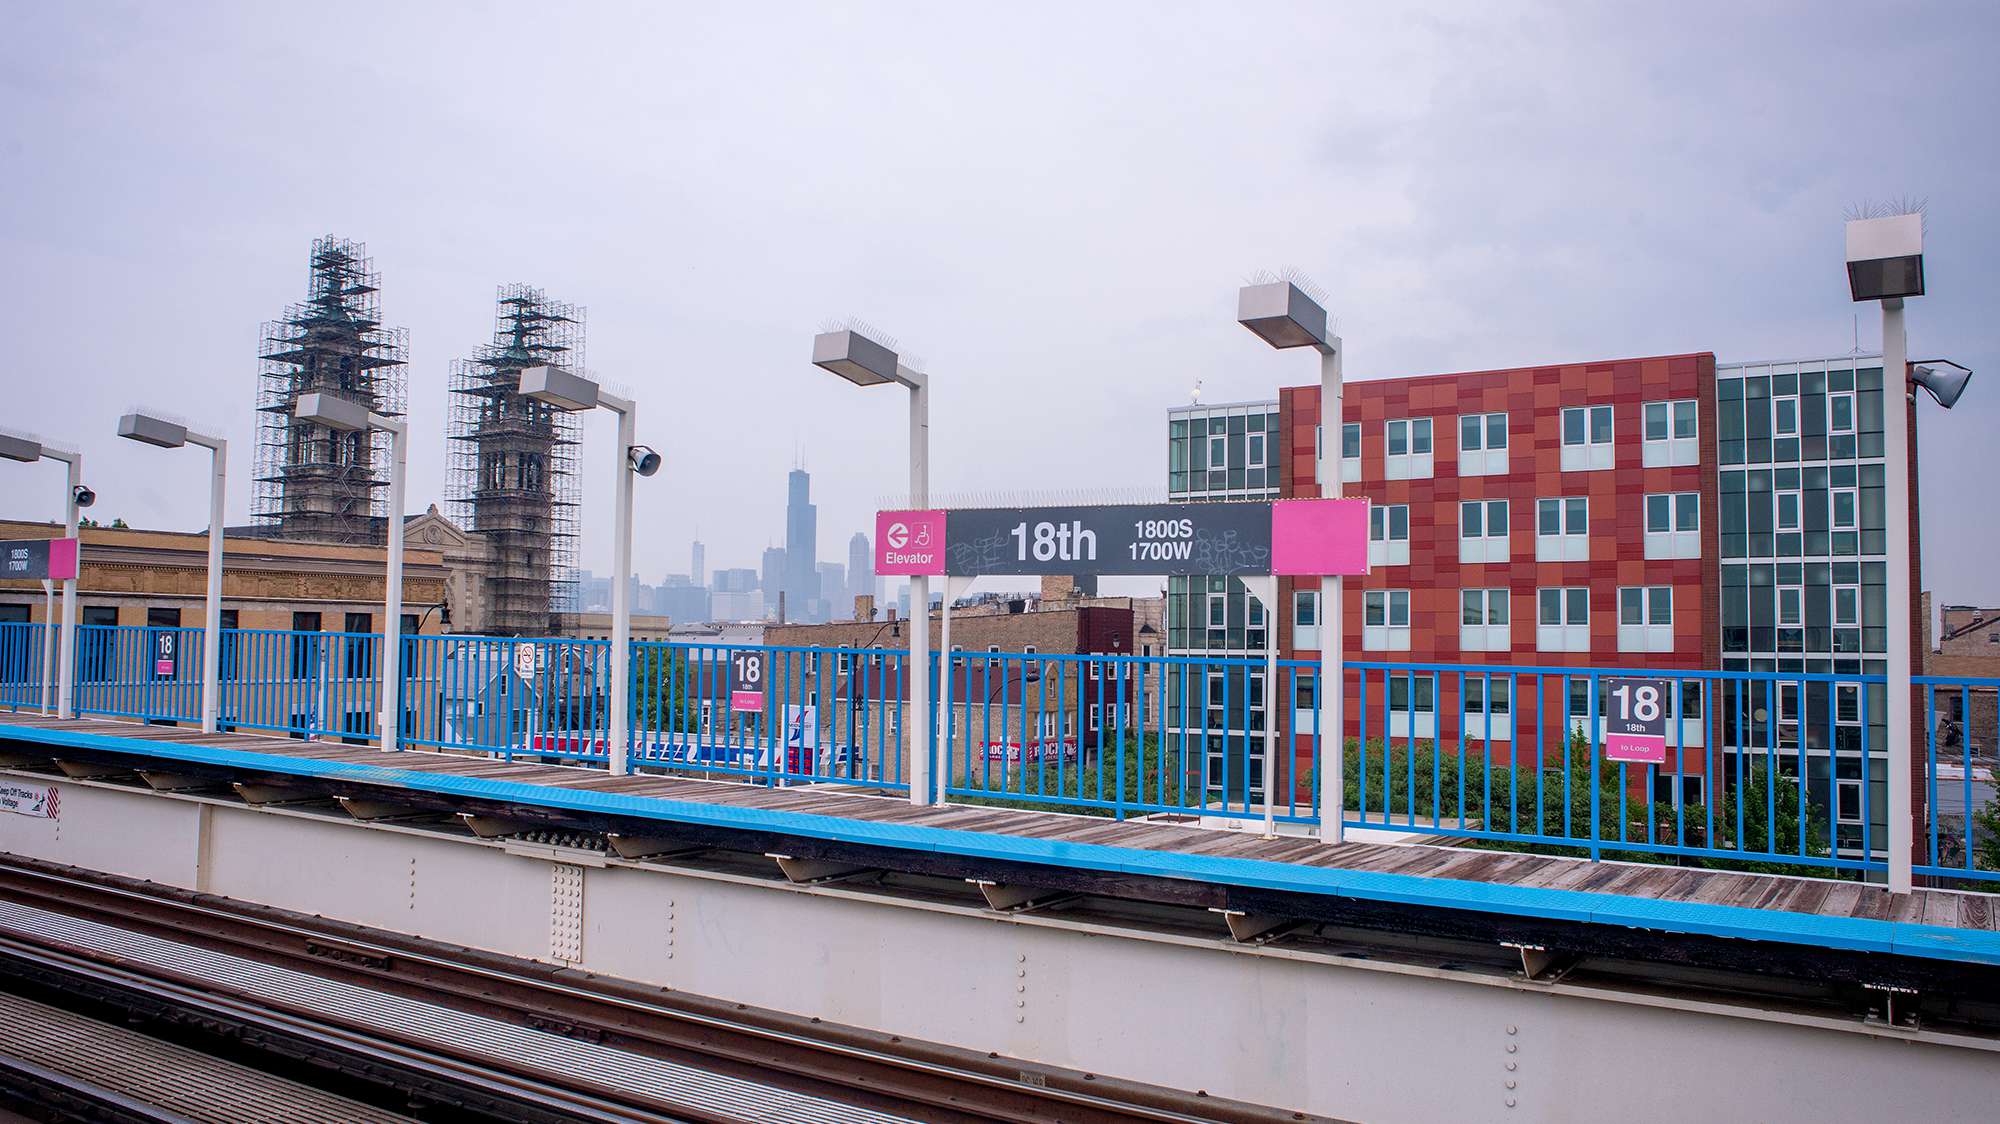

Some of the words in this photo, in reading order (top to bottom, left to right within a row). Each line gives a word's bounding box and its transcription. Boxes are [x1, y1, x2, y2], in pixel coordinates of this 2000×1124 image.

[1135, 519, 1192, 538] 1800S
[1011, 522, 1096, 560] 18th
[11, 548, 28, 559] 1800S
[886, 552, 933, 564] Elevator
[1129, 542, 1192, 560] 1700W
[9, 560, 28, 571] 1700W
[160, 636, 172, 654] 18
[736, 656, 760, 683] 18
[1612, 685, 1659, 721] 18
[1626, 724, 1646, 732] 18th
[18, 789, 33, 799] Tracks
